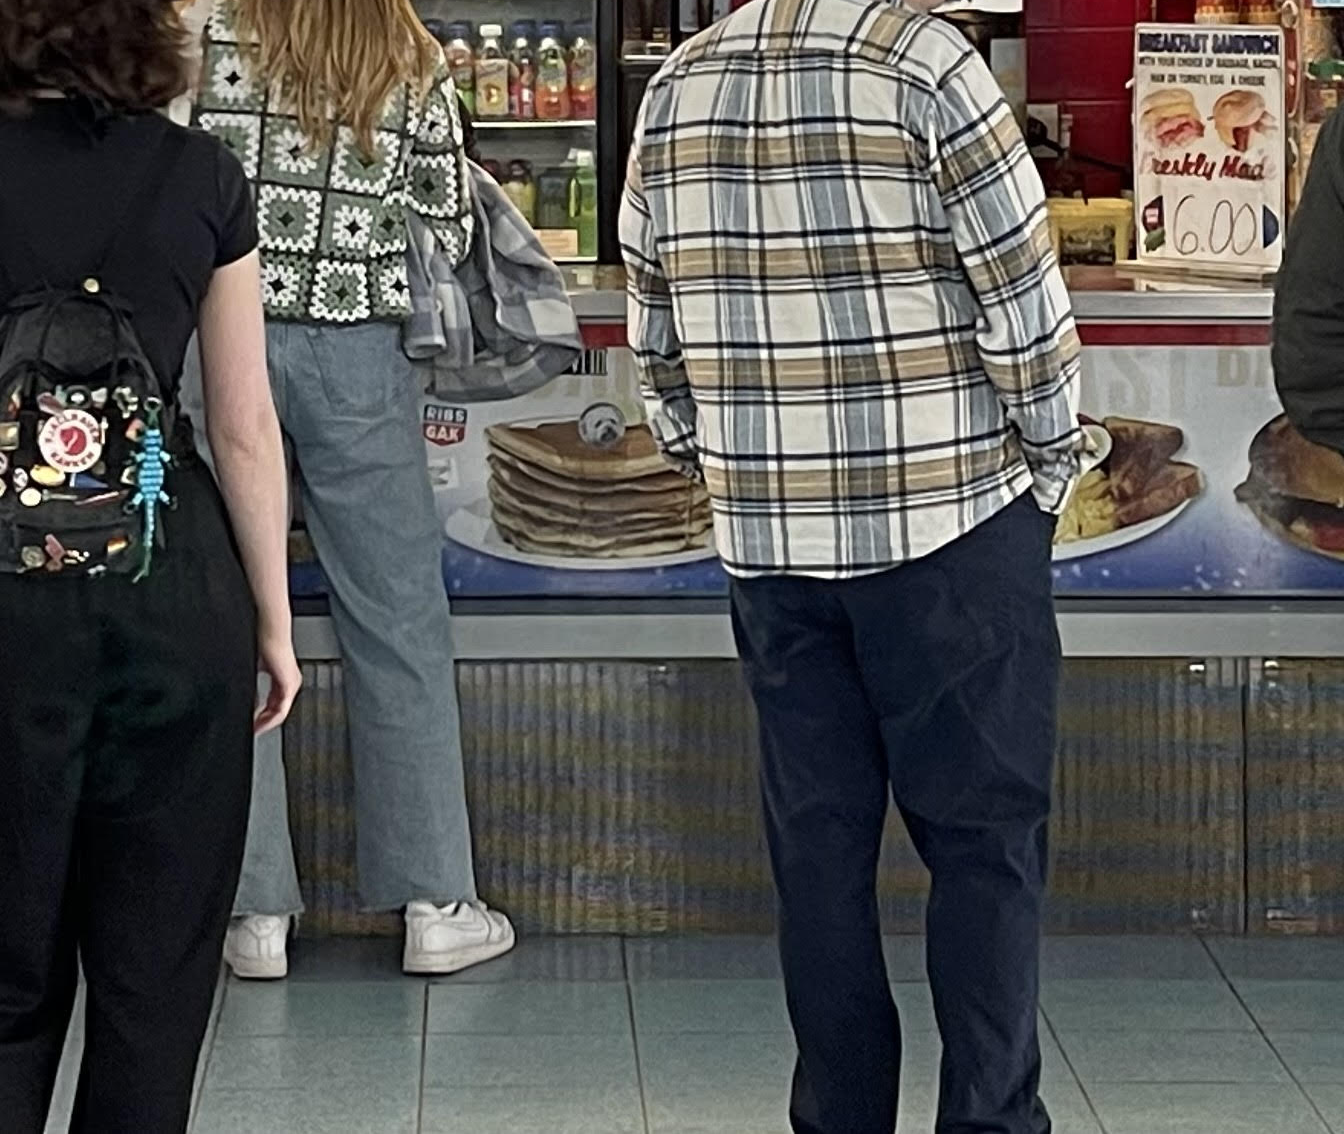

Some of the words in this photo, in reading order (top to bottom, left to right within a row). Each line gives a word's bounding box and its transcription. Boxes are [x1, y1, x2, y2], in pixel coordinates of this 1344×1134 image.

[1139, 33, 1209, 54] BREAKFAST
[1173, 194, 1257, 256] 6.00
[426, 406, 465, 422] RIBS
